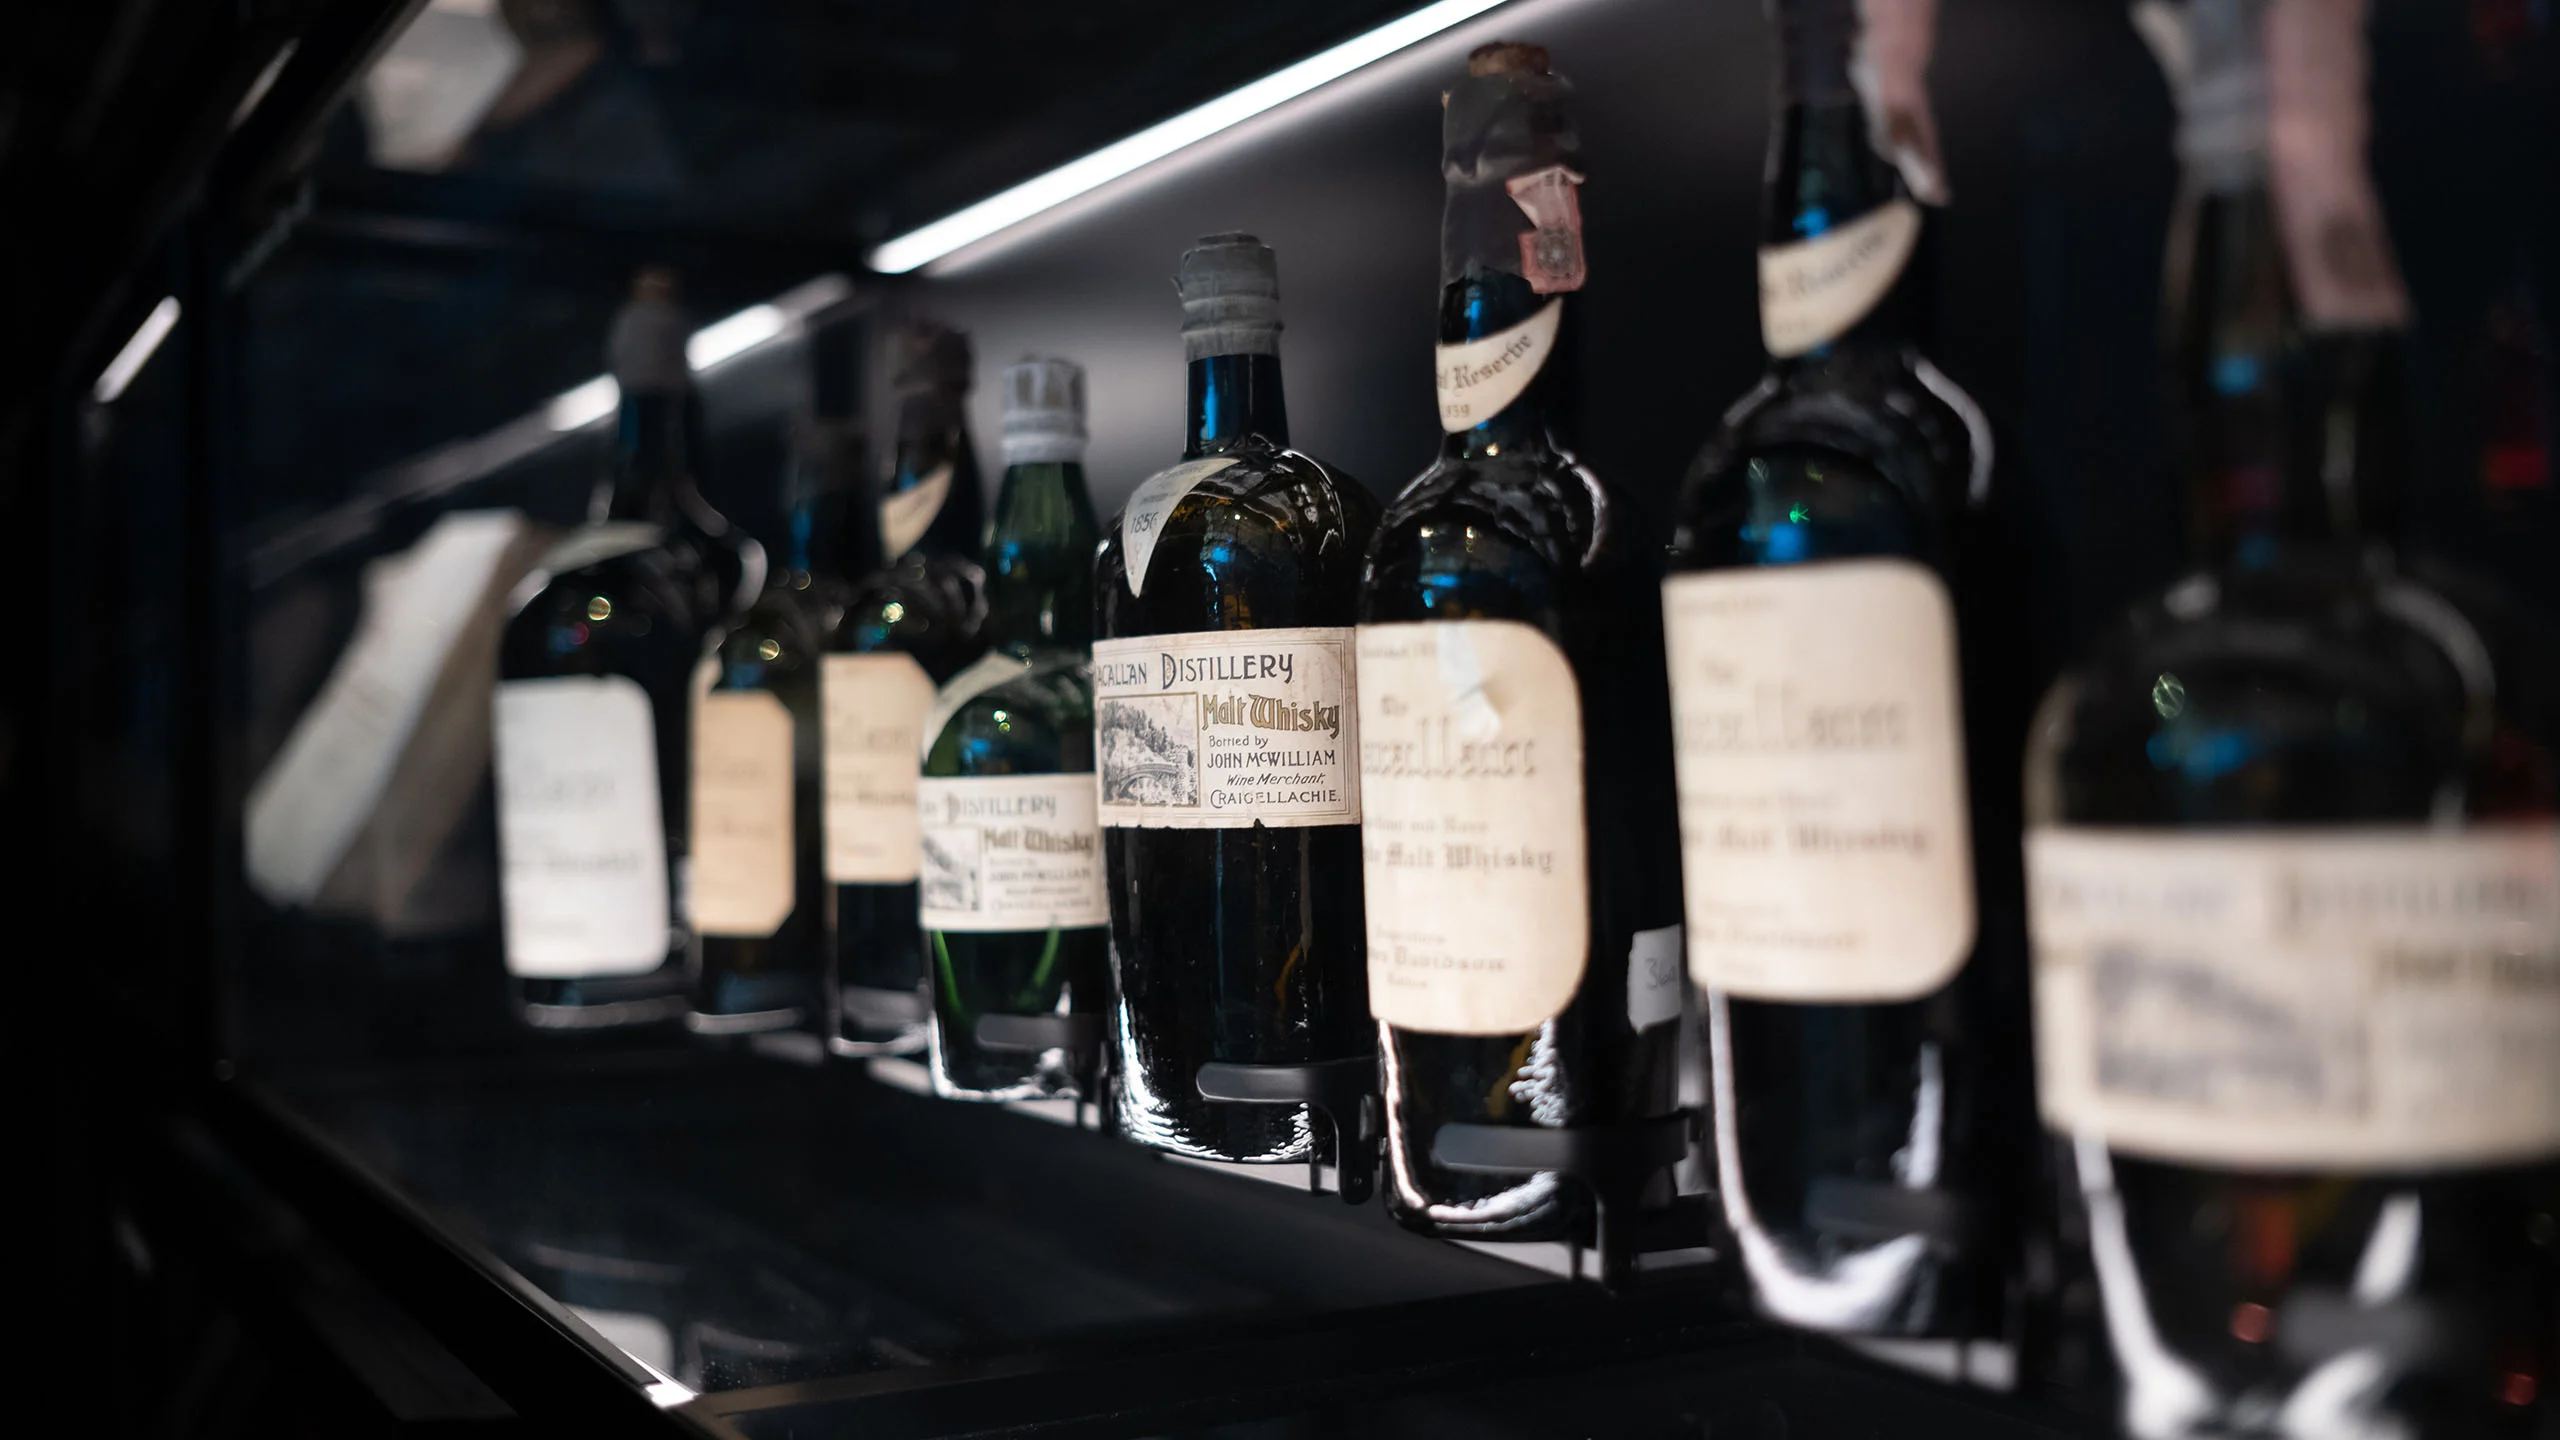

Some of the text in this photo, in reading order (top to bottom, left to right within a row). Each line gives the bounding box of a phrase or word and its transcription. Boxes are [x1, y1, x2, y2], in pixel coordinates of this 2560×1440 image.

[1452, 333, 1533, 391] Reserve
[1161, 653, 1294, 690] DISTILLERY
[1201, 693, 1340, 740] Malt Whisky
[1254, 735, 1269, 749] by
[1207, 752, 1243, 768] JOHN
[1226, 773, 1255, 786] Wine
